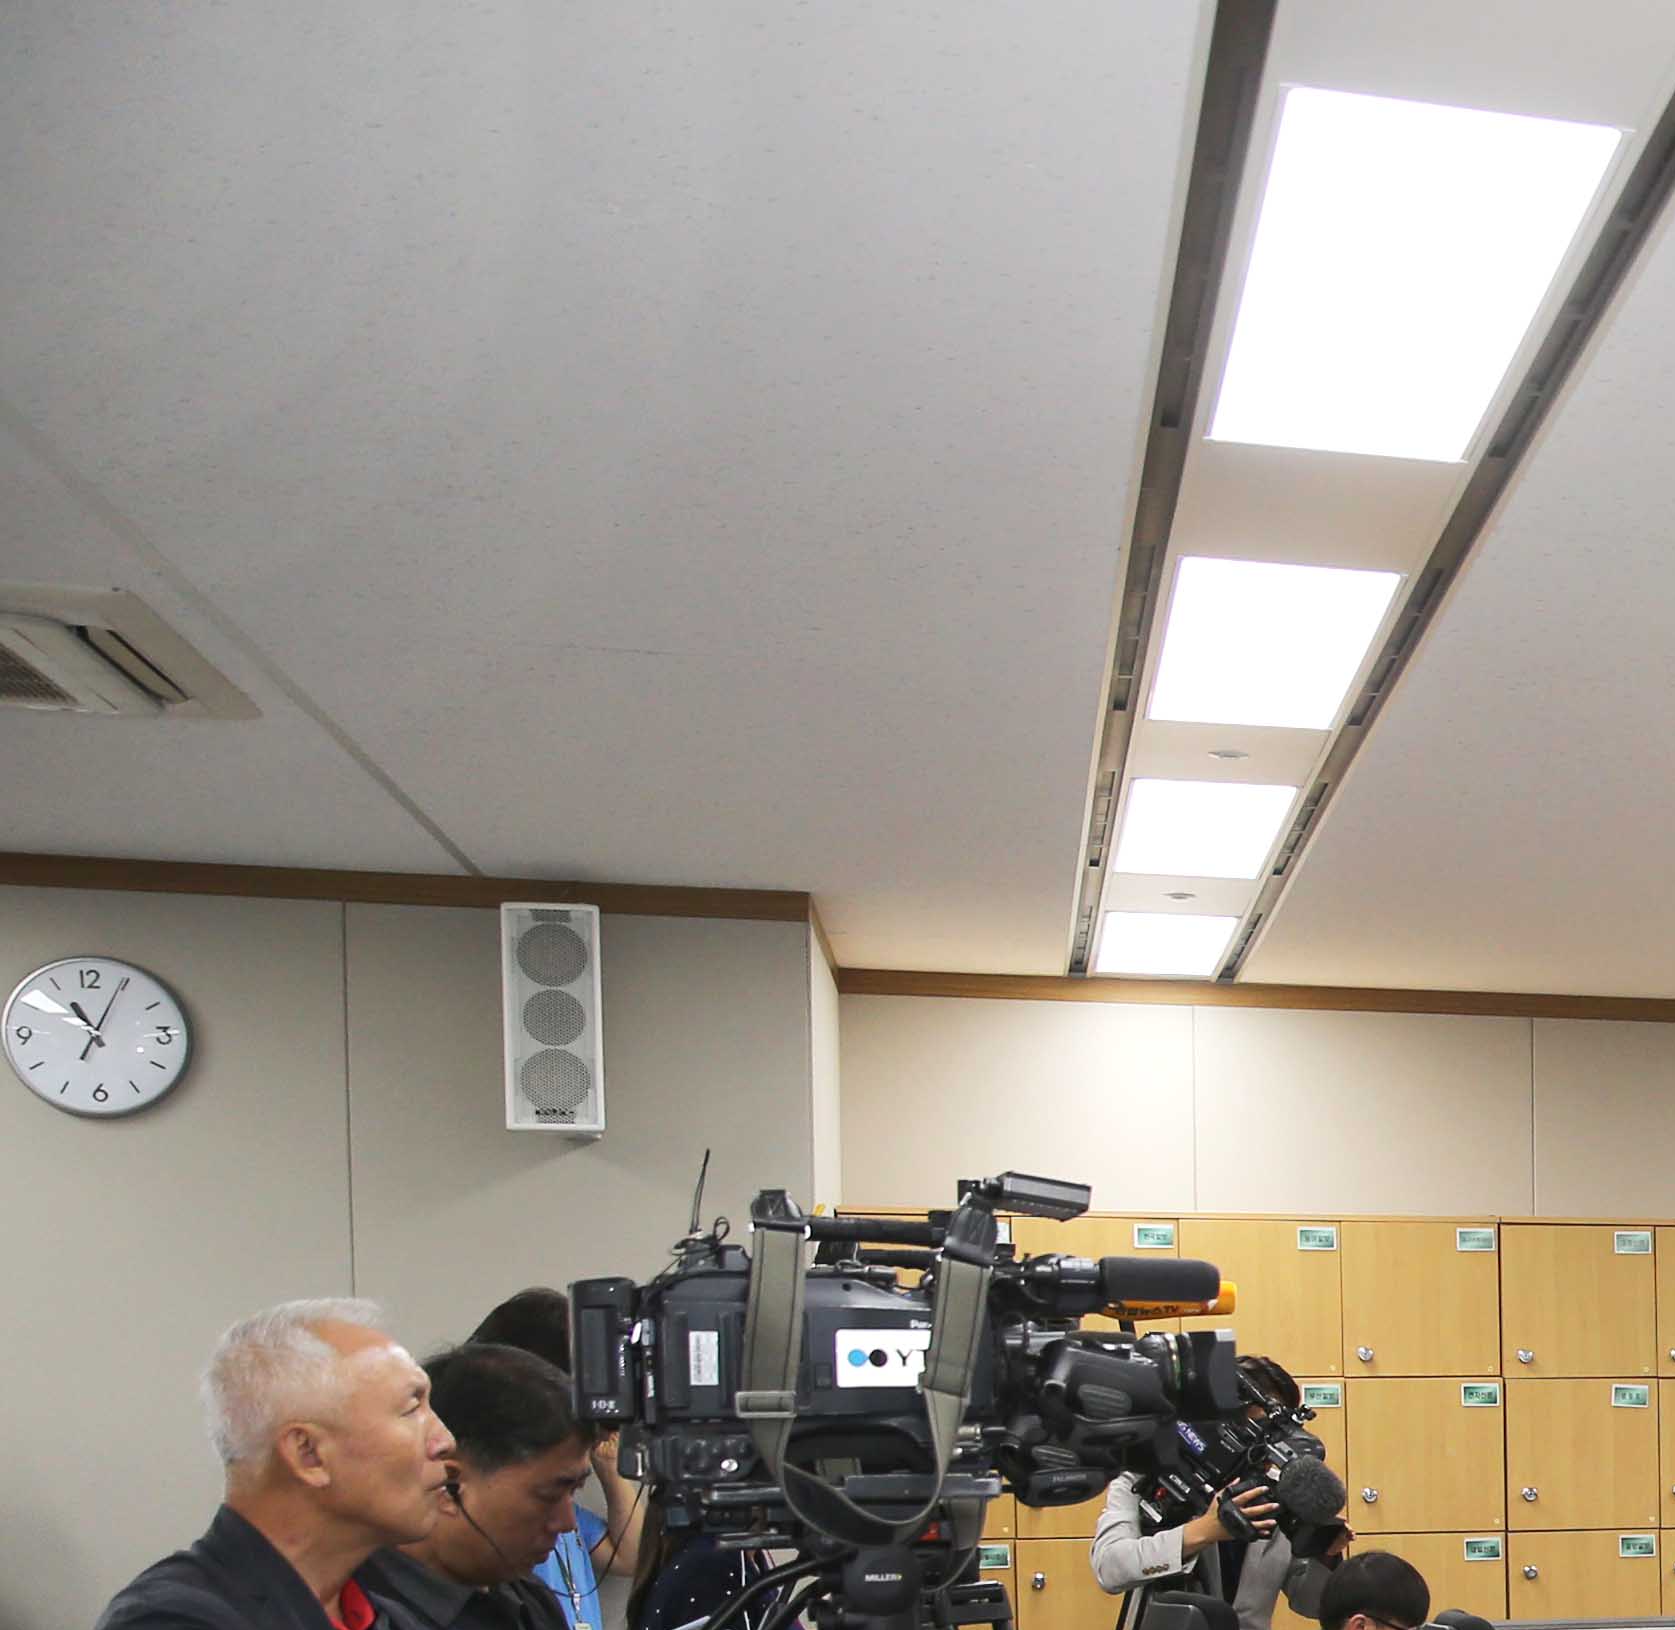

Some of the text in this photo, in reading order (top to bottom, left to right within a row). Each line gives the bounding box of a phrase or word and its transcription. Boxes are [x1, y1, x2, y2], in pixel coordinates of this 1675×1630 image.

[80, 970, 101, 989] 12
[16, 1026, 32, 1045] 9
[93, 1083, 108, 1102] 6
